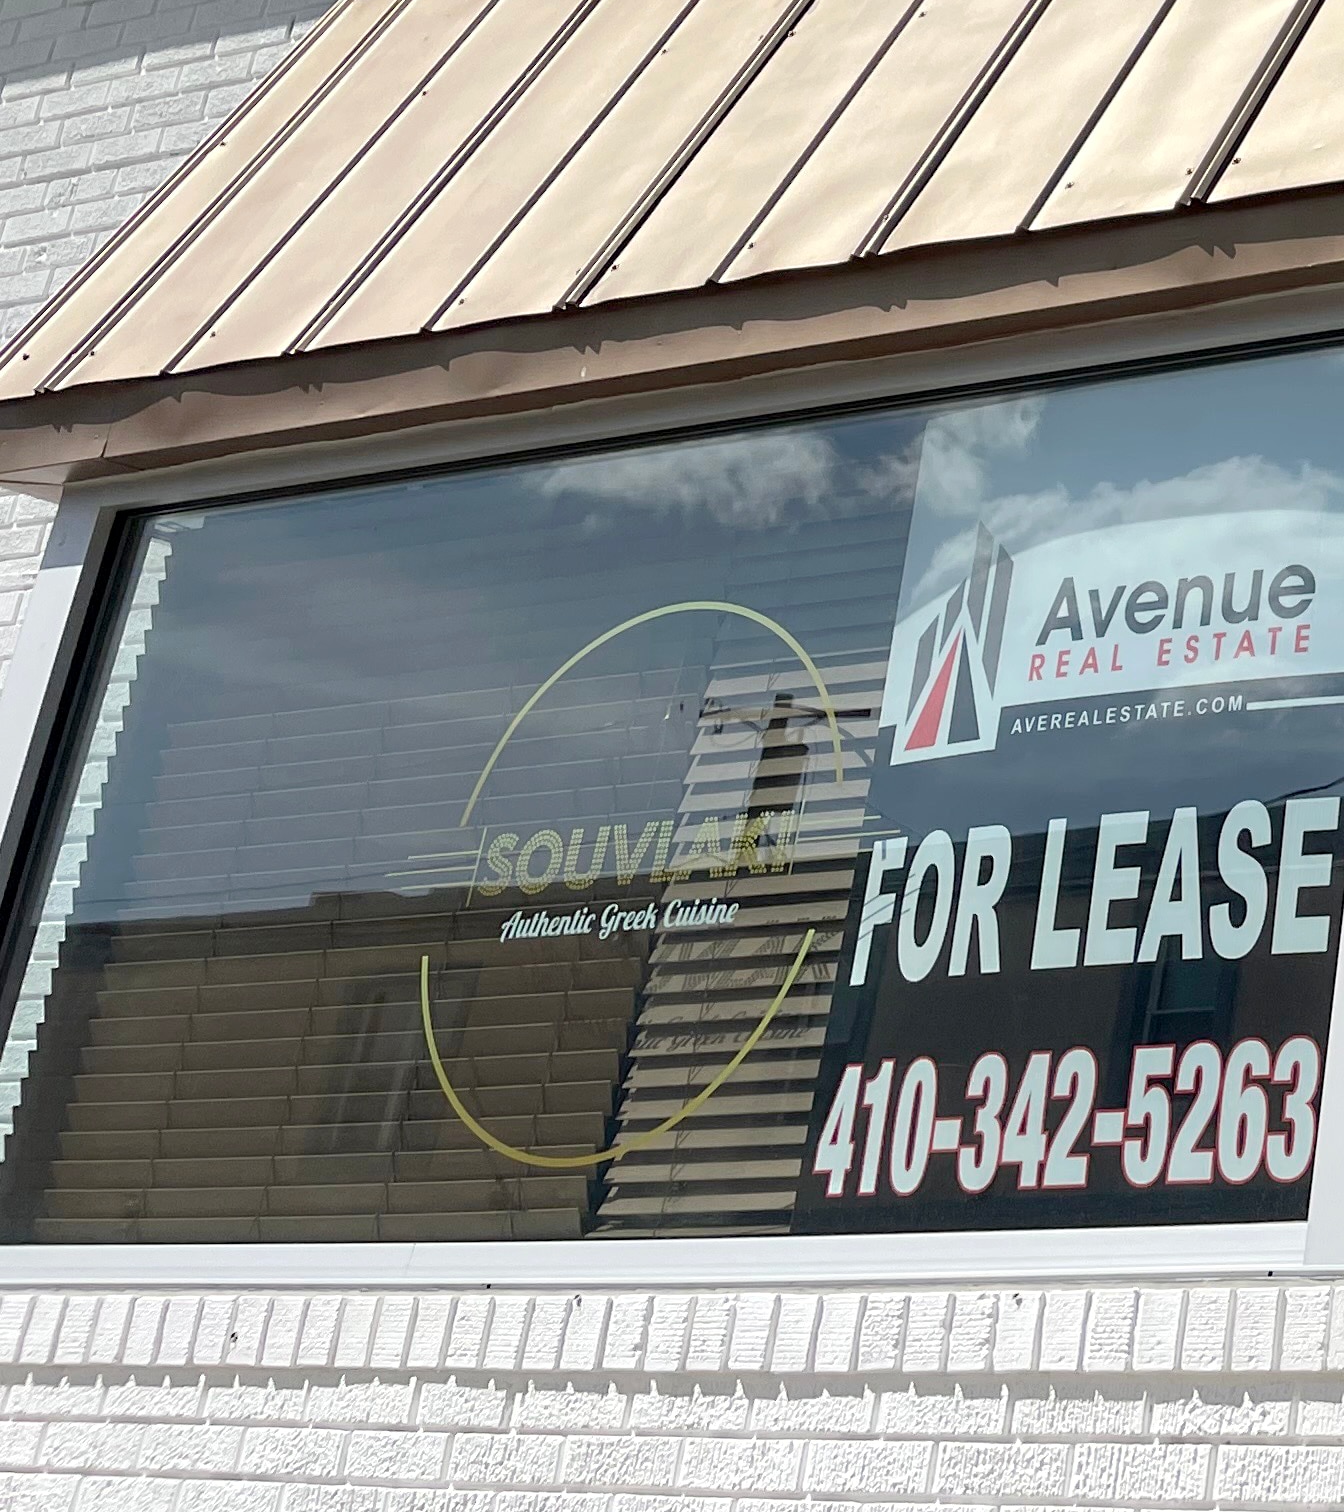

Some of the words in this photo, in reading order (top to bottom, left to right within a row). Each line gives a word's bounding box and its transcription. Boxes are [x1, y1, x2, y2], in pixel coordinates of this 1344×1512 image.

[1035, 563, 1317, 647] Avenue
[1028, 642, 1125, 682] REAL
[1156, 623, 1313, 668] ESTATE
[1009, 694, 1245, 736] AVEREALESTATE.COM
[477, 809, 796, 897] SOUVLAKI
[849, 824, 1012, 987] FOR
[1030, 797, 1341, 970] LEASE
[499, 906, 597, 943] Authentic
[598, 902, 658, 941] Greek
[662, 896, 740, 930] Cuisine
[812, 1035, 1321, 1199] 410-342-5263
